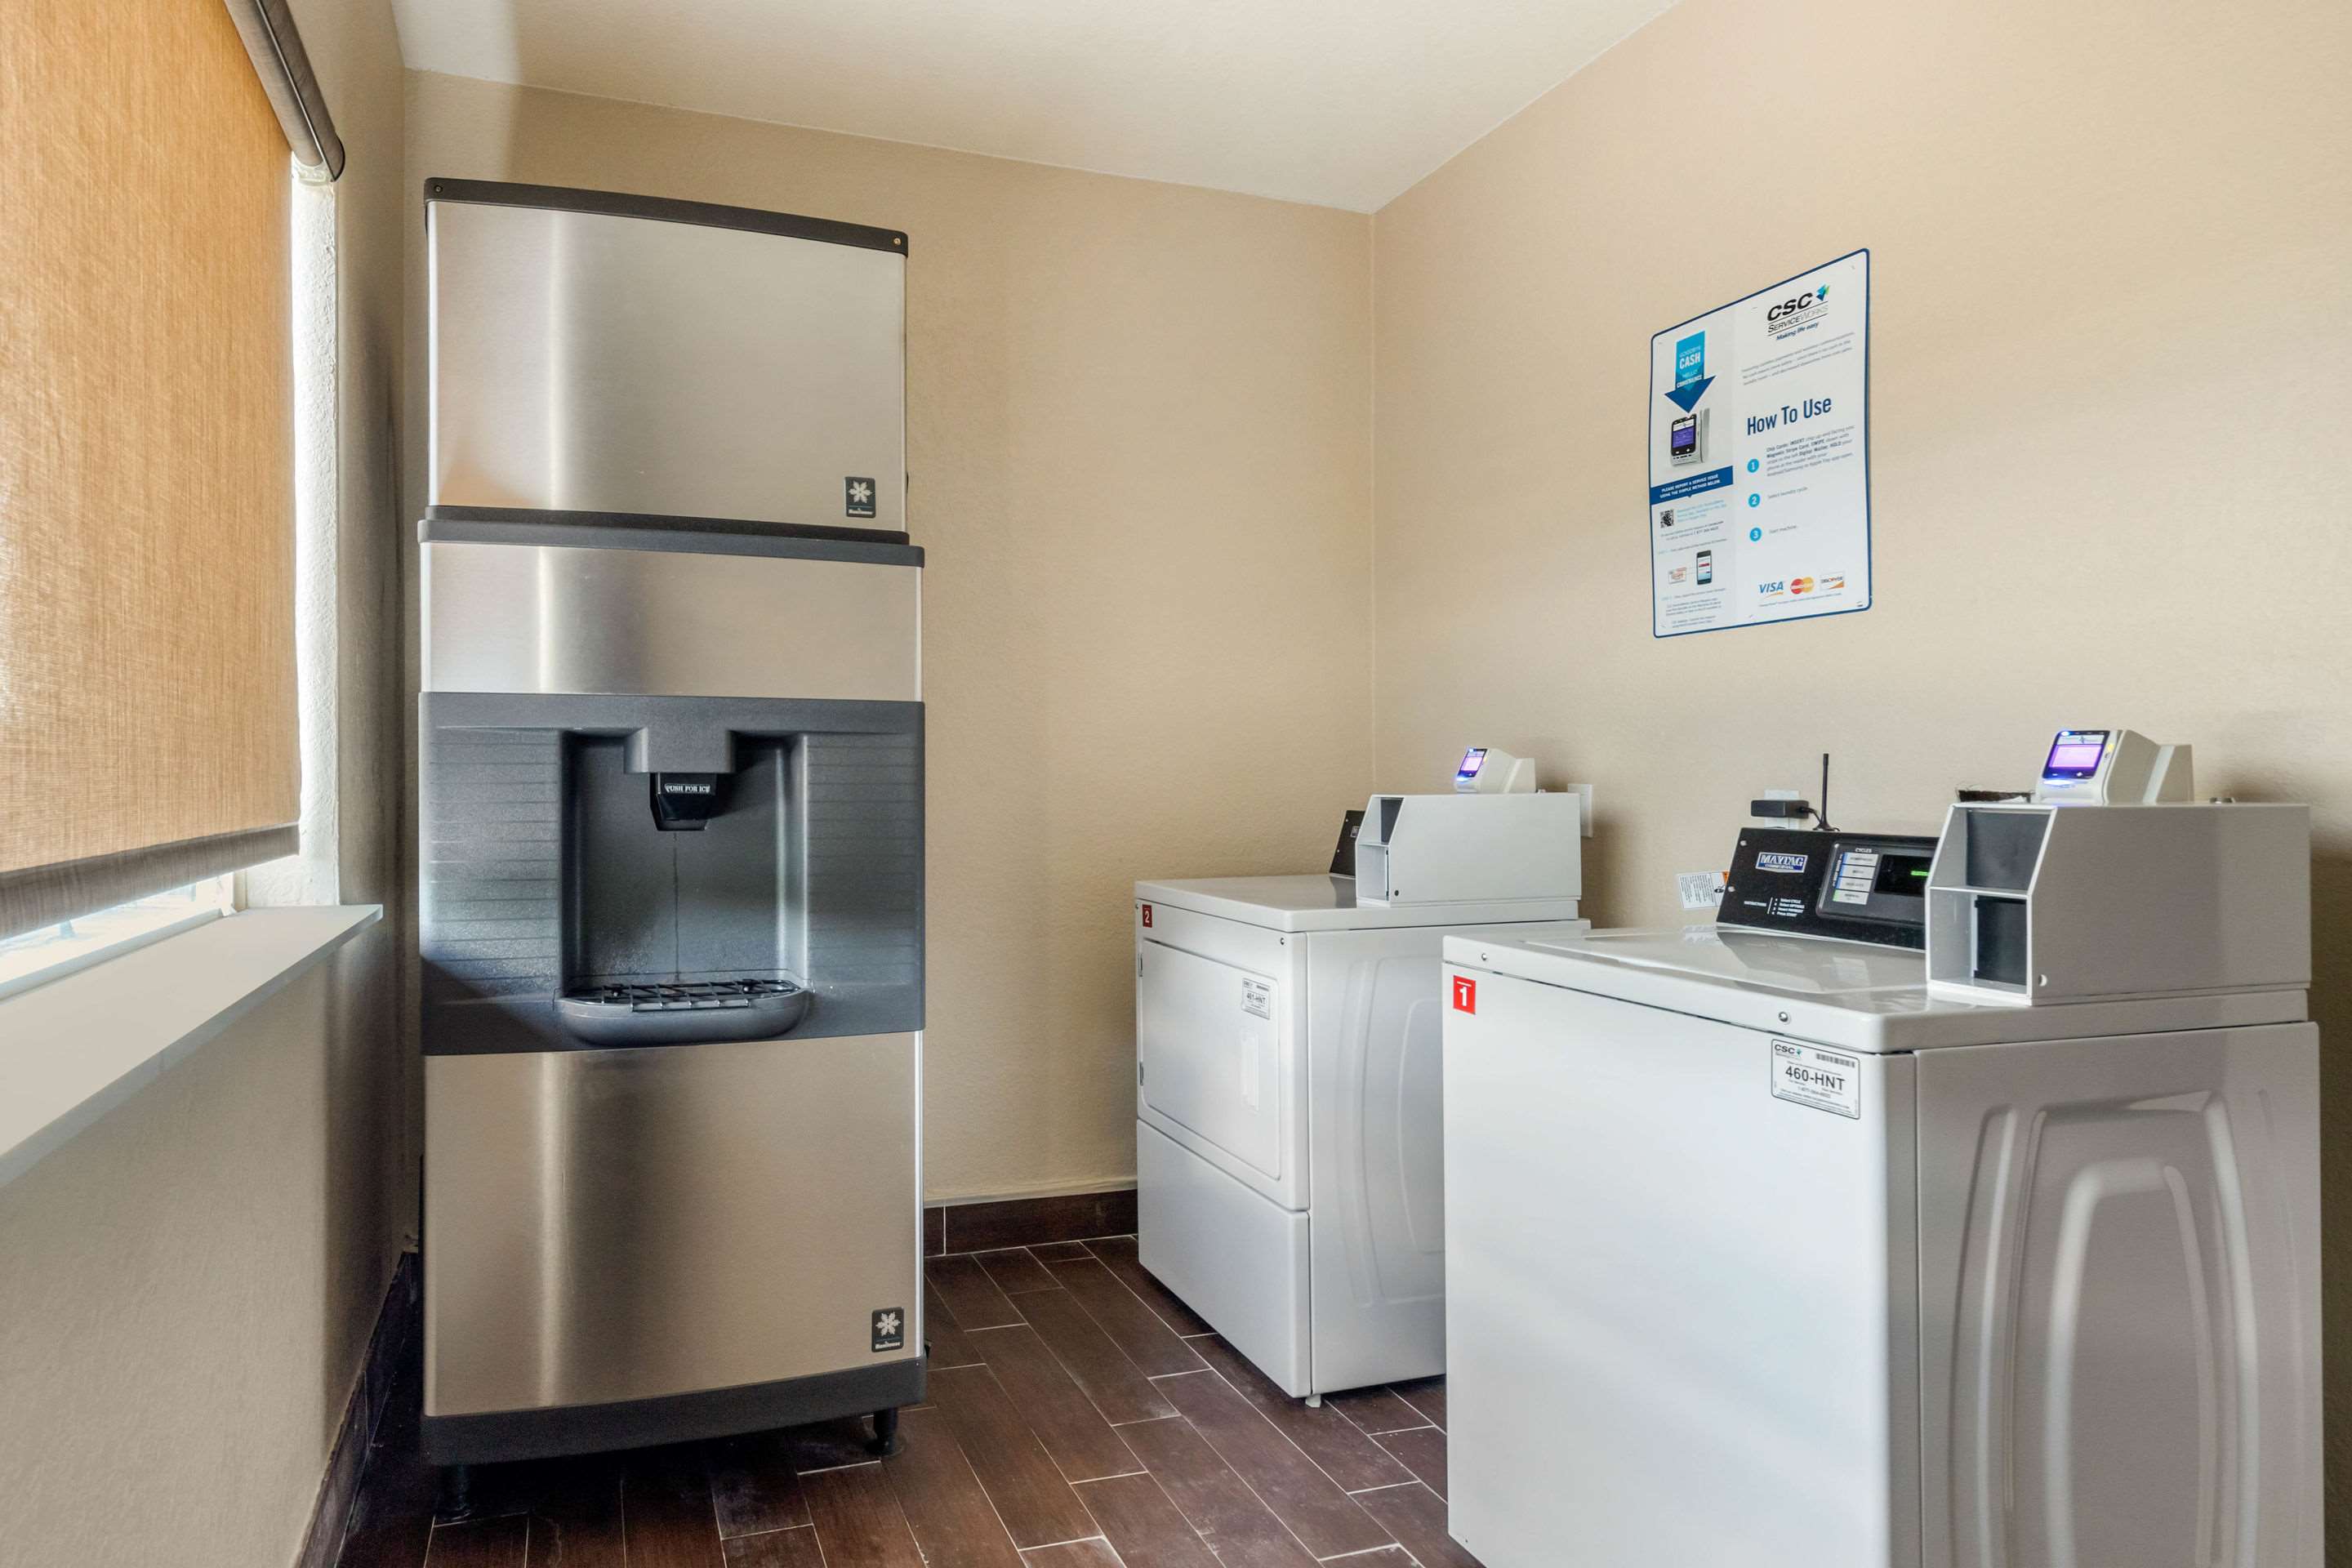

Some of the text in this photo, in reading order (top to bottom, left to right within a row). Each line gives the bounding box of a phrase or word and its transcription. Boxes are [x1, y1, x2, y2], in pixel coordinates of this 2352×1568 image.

[1767, 292, 1813, 321] CSC
[1776, 330, 1797, 341] Making
[1806, 322, 1820, 331] easy
[1679, 351, 1700, 369] CASH
[1747, 399, 1832, 436] How To Use
[1751, 461, 1756, 470] 1
[1752, 496, 1757, 505] 2
[1753, 530, 1758, 539] 3
[1759, 581, 1784, 594] VISA
[1760, 855, 1803, 866] MAYTAG
[1144, 910, 1151, 924] 2
[1459, 987, 1468, 1007] 1
[1774, 1045, 1796, 1054] CSC
[1785, 1066, 1846, 1091] 460-HNT
